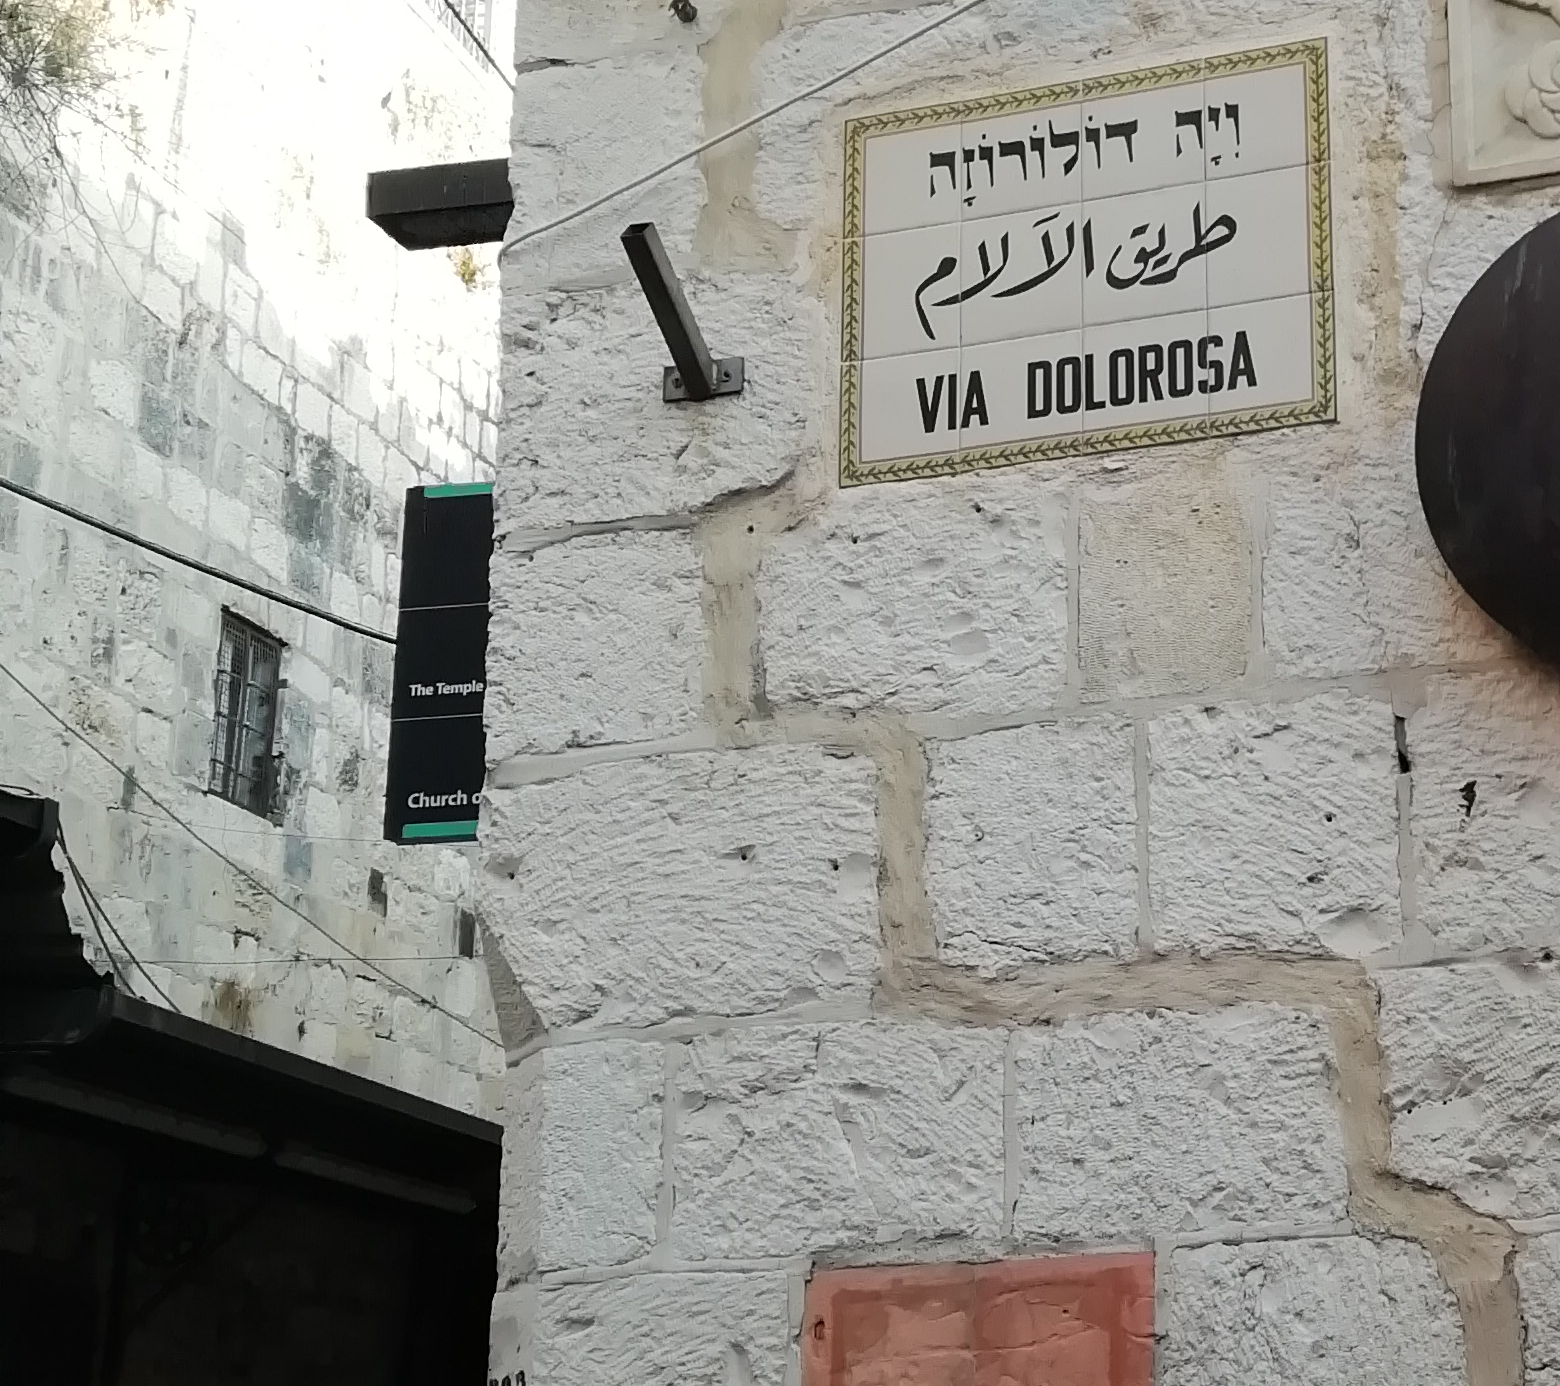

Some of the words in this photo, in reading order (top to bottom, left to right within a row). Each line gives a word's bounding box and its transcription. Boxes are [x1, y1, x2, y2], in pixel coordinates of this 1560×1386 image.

[1106, 200, 1238, 290] طريق
[916, 370, 990, 434] VIA
[1026, 330, 1257, 420] DOLOROSA
[408, 683, 434, 697] The
[436, 679, 484, 696] Temple
[407, 789, 468, 809] Church
